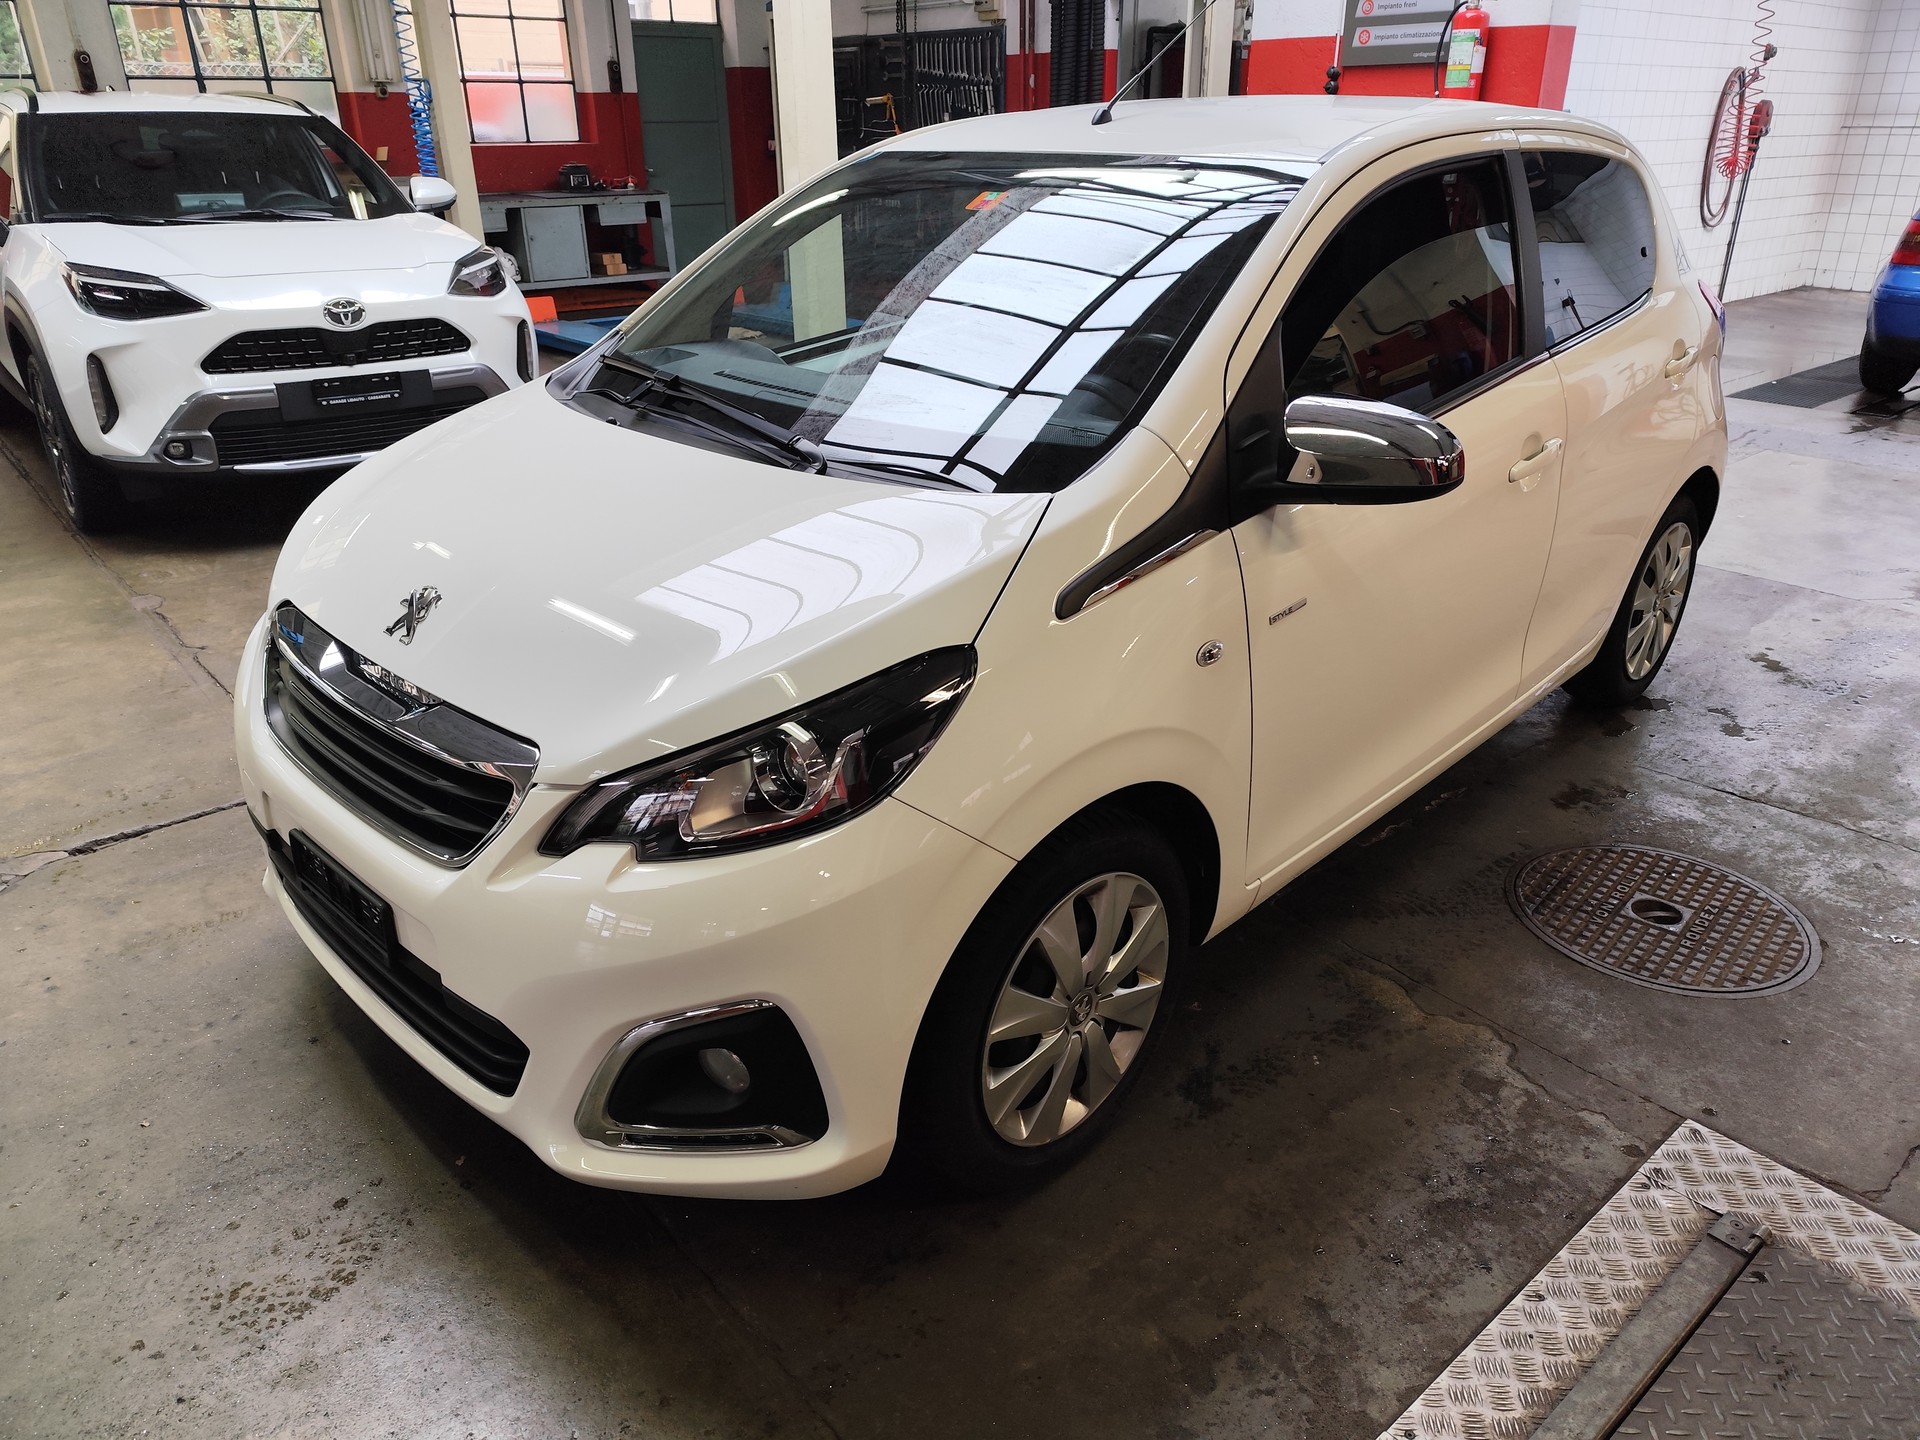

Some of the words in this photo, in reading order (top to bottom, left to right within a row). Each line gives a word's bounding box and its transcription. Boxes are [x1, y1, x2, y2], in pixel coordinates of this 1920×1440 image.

[1377, 2, 1403, 11] Impianto
[1374, 33, 1399, 42] Impianto
[1271, 606, 1293, 624] STYLE
[1590, 902, 1615, 925] VON
[1611, 873, 1640, 899] ROLL
[1680, 904, 1720, 948] RONDEZ
